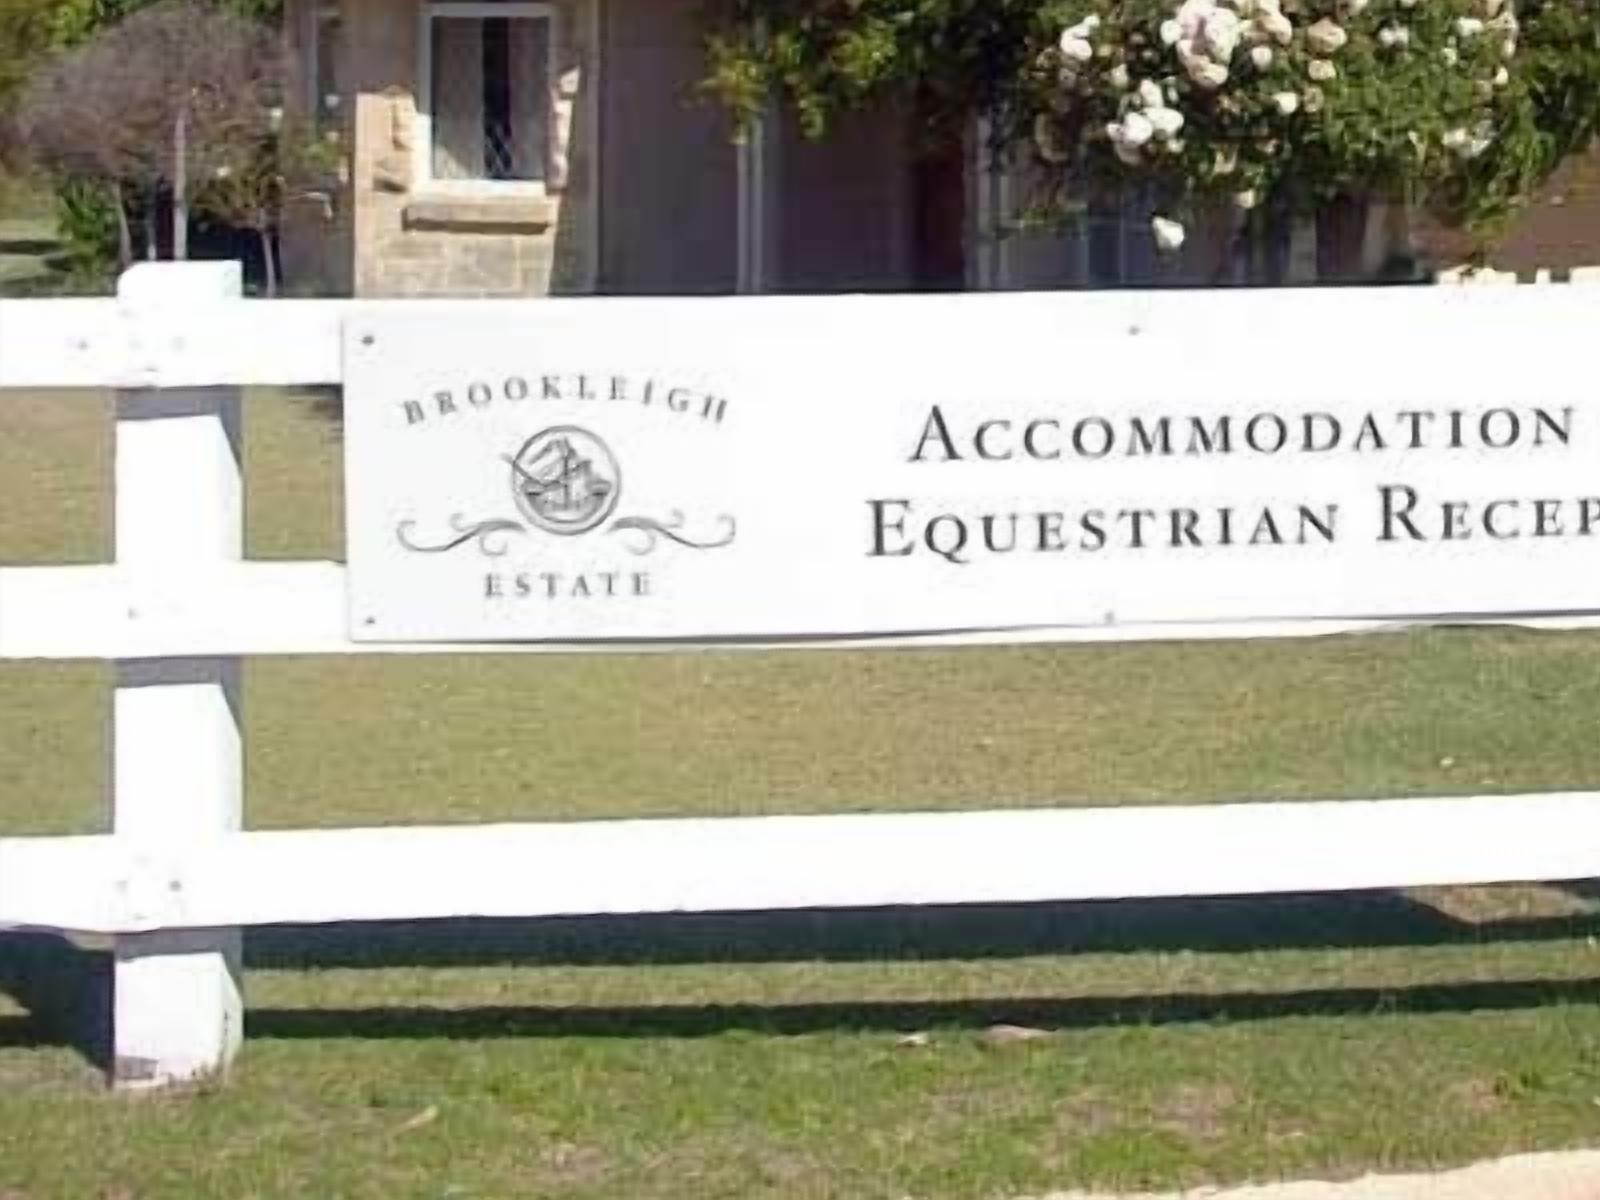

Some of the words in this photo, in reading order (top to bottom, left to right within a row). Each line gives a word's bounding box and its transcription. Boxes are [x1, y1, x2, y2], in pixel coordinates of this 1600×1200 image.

[402, 375, 728, 425] BROOKLEIGH
[907, 403, 1575, 463] ACCOMMODATION
[865, 498, 1339, 565] EQUESTRIAN
[484, 571, 652, 599] ESTATE
